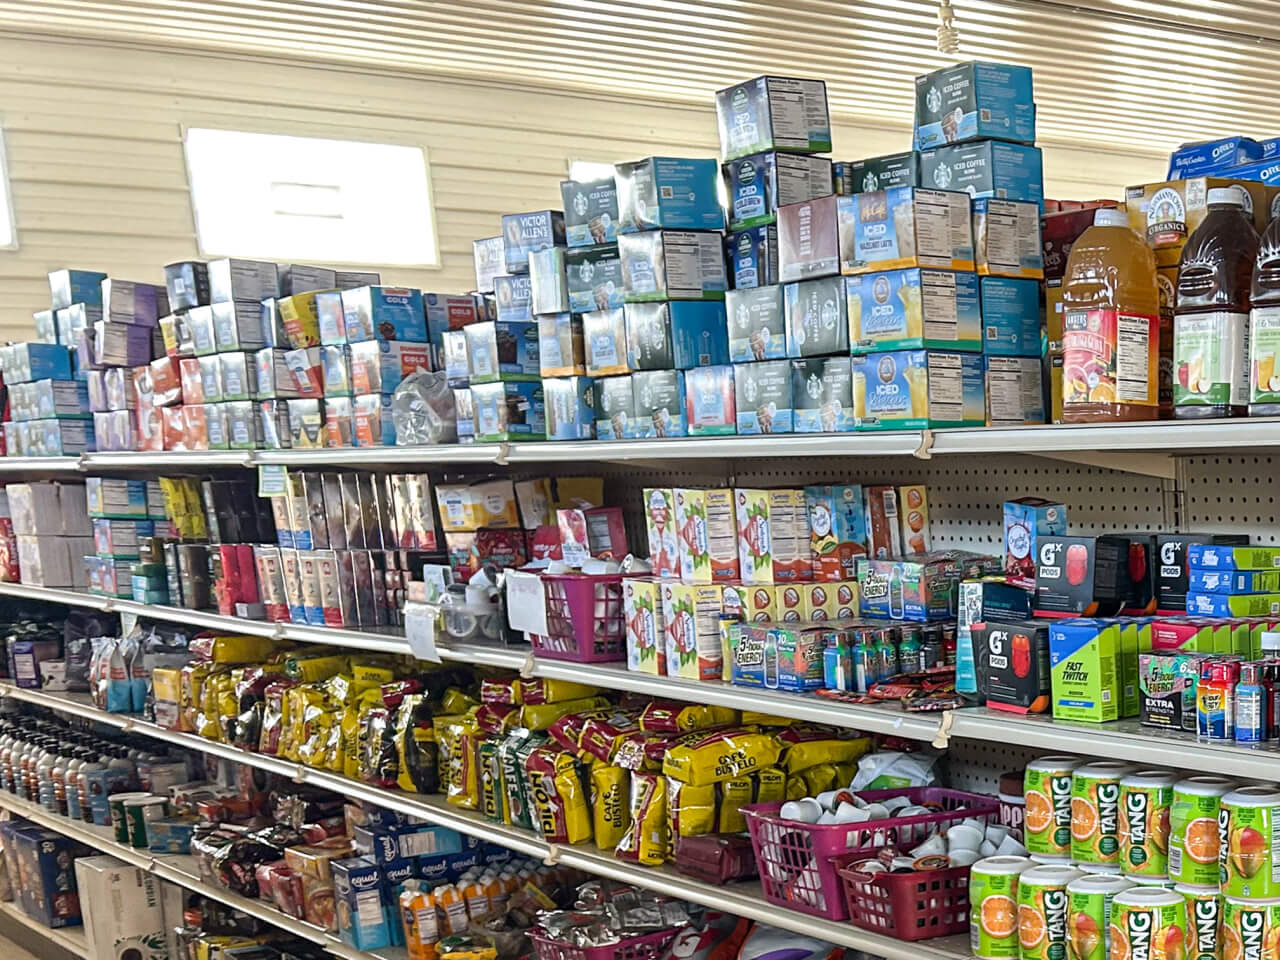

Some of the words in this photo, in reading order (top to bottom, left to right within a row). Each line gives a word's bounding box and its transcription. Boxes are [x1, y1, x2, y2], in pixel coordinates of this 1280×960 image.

[1212, 141, 1235, 158] OREO
[966, 159, 985, 168] COFFEE
[520, 216, 546, 226] VICTOR
[521, 227, 548, 239] ALLEN'S
[864, 225, 886, 236] ICED
[872, 305, 894, 316] ICED
[876, 385, 899, 394] ICED
[1066, 661, 1082, 672] FAST
[1062, 670, 1089, 682] TWITCH
[1146, 699, 1174, 708] EXTRA
[530, 772, 555, 836] PILON
[1055, 776, 1072, 826] TANG
[1101, 784, 1119, 833] TANG
[1130, 793, 1147, 845] TANG
[422, 860, 447, 875] equal
[352, 872, 379, 888] equal
[1049, 890, 1065, 942] TANG
[1198, 900, 1219, 949] TANG
